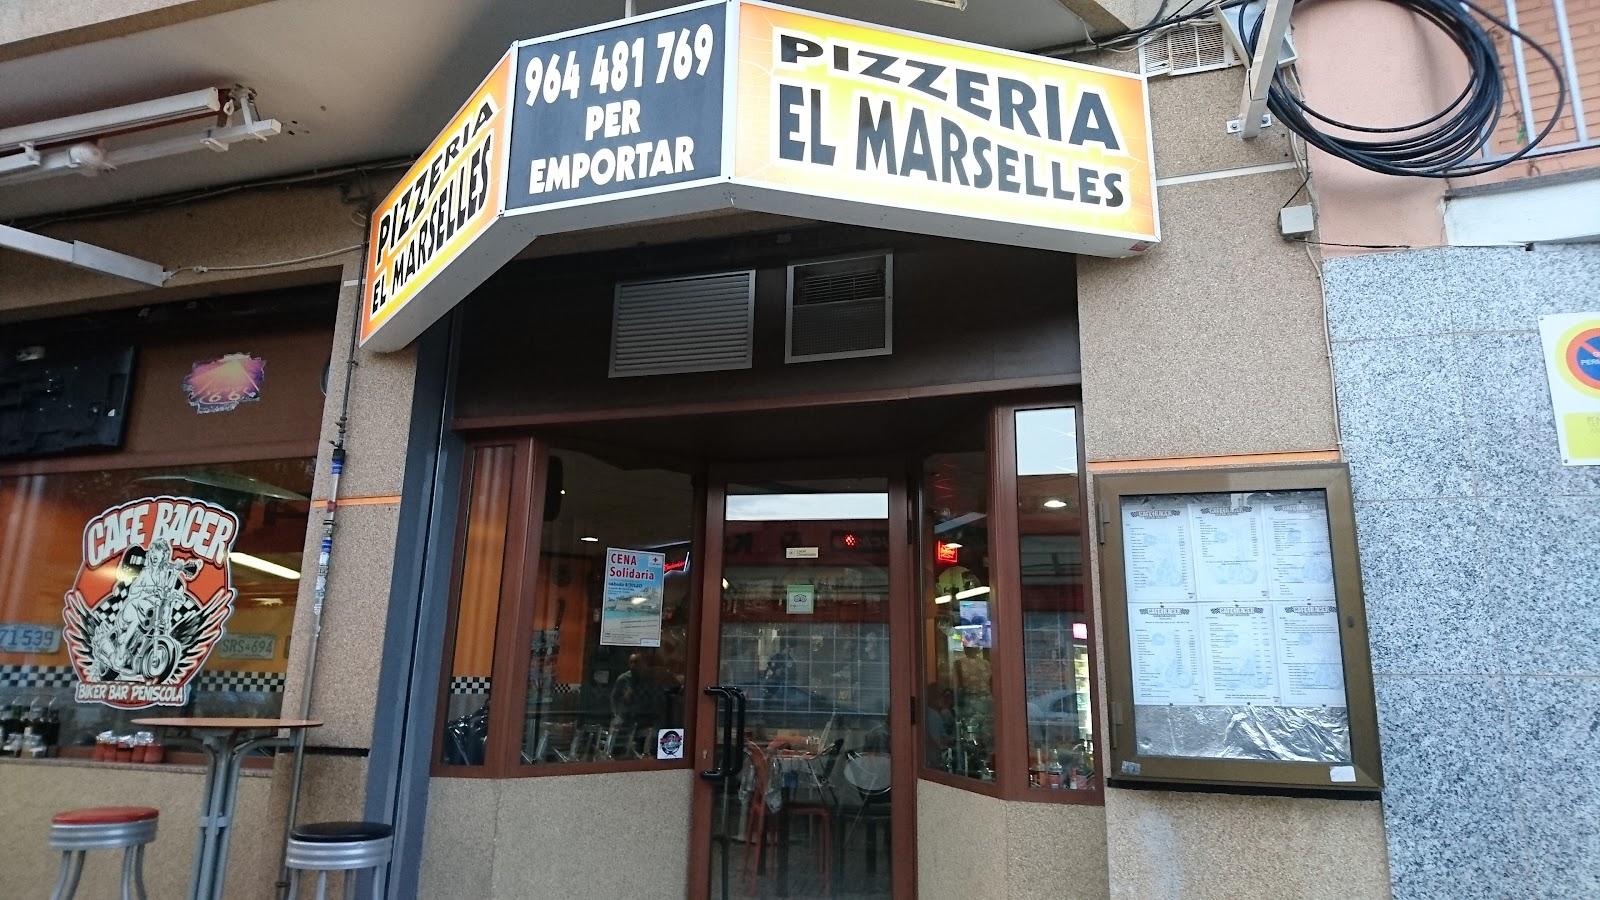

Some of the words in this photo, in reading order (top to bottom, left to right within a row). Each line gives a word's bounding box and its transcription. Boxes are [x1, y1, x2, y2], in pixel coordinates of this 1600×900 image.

[525, 53, 581, 107] 964
[590, 37, 645, 94] 481
[655, 23, 714, 84] 769
[780, 34, 1121, 151] PIZZERIA
[585, 100, 641, 141] PER
[779, 83, 837, 166] EL
[855, 95, 1124, 208] MARSELLES
[376, 100, 495, 266] PIZZERIA
[529, 136, 695, 194] EMPORTAR
[372, 276, 388, 315] EL
[392, 136, 494, 295] MARSELLES
[87, 503, 150, 567] CAFE
[151, 501, 233, 564] RACER
[611, 553, 637, 565] CENA
[609, 566, 655, 580] Solidaria
[79, 683, 107, 699] BIKER
[108, 684, 129, 700] BAR
